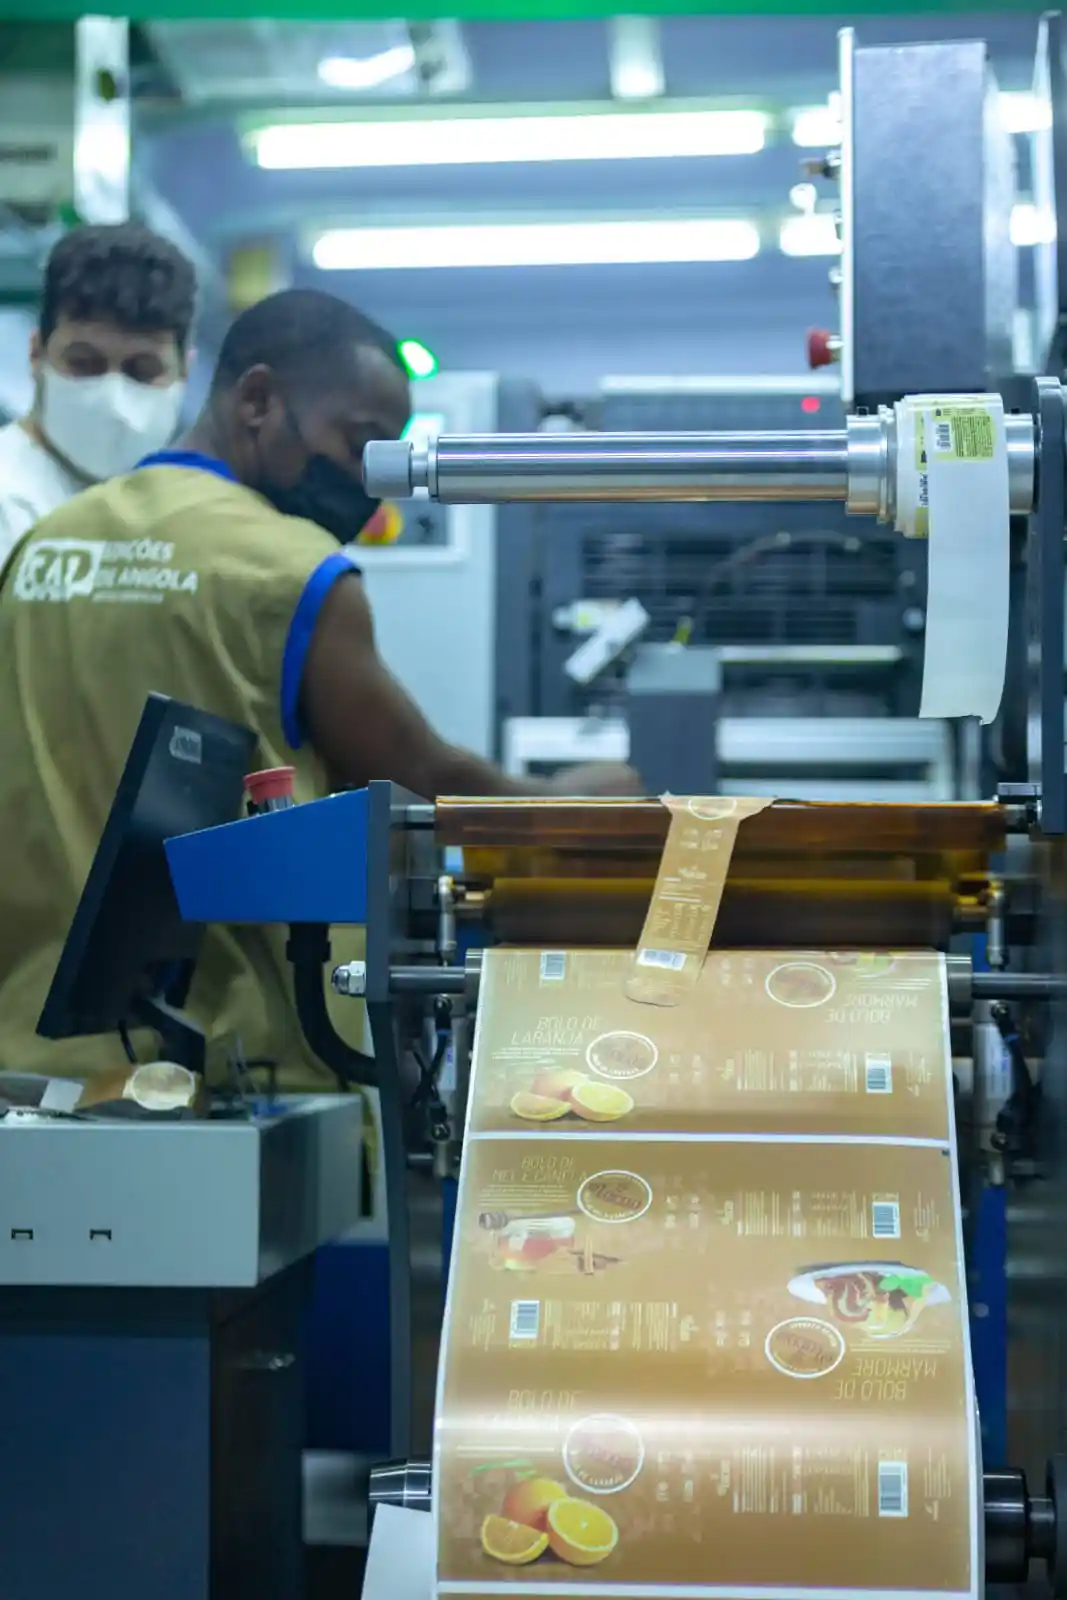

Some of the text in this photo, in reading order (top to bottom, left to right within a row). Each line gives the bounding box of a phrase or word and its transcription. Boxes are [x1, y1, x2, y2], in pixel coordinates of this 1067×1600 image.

[511, 1030, 584, 1046] LARANJA
[830, 1379, 907, 1401] BOLO DE
